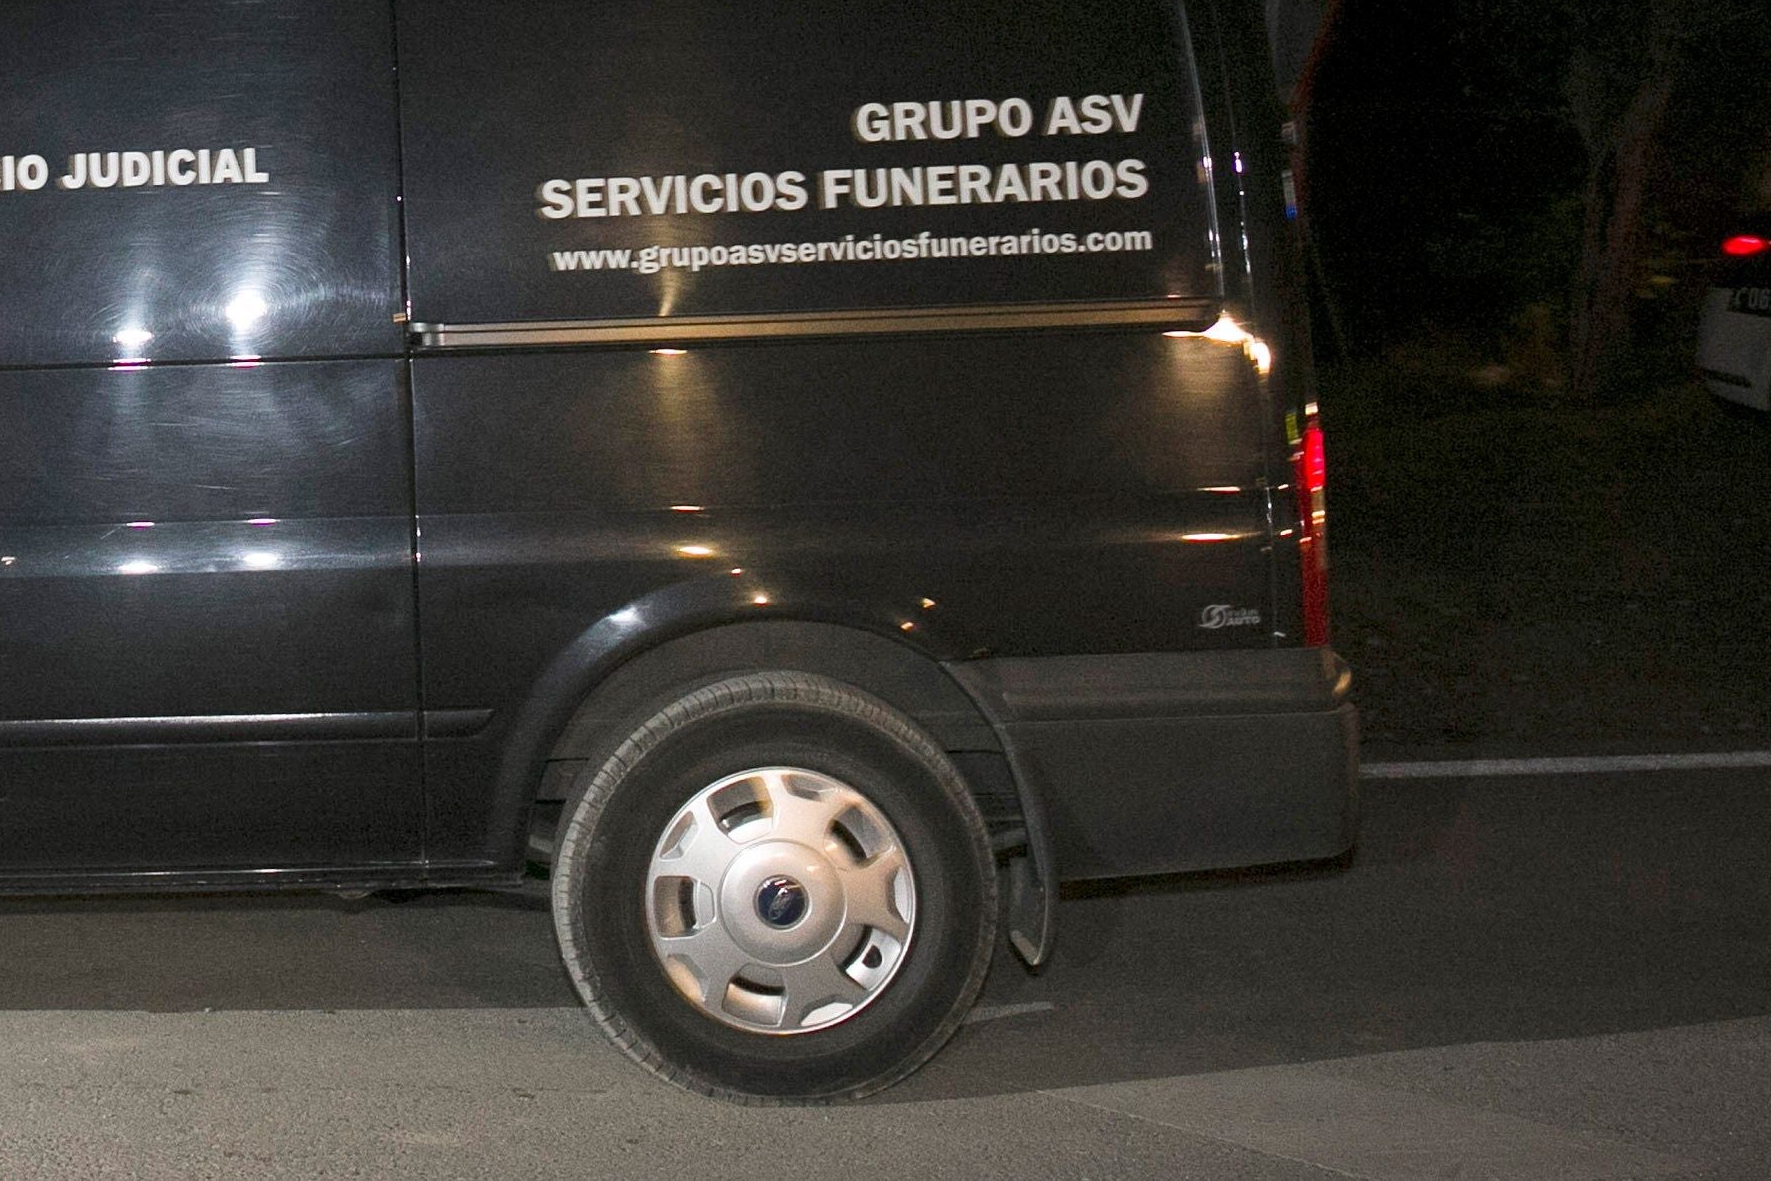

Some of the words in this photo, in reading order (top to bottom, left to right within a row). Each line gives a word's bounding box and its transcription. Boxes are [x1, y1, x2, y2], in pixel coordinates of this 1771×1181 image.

[855, 98, 1033, 142] GRUPO
[1046, 94, 1144, 135] ASV
[61, 148, 270, 190] JUDICIAL
[540, 171, 809, 219] SERVICIOS
[822, 159, 1148, 209] FUNERARIOS
[551, 228, 1153, 274] www.grupoasvserviciosfunerarios.com
